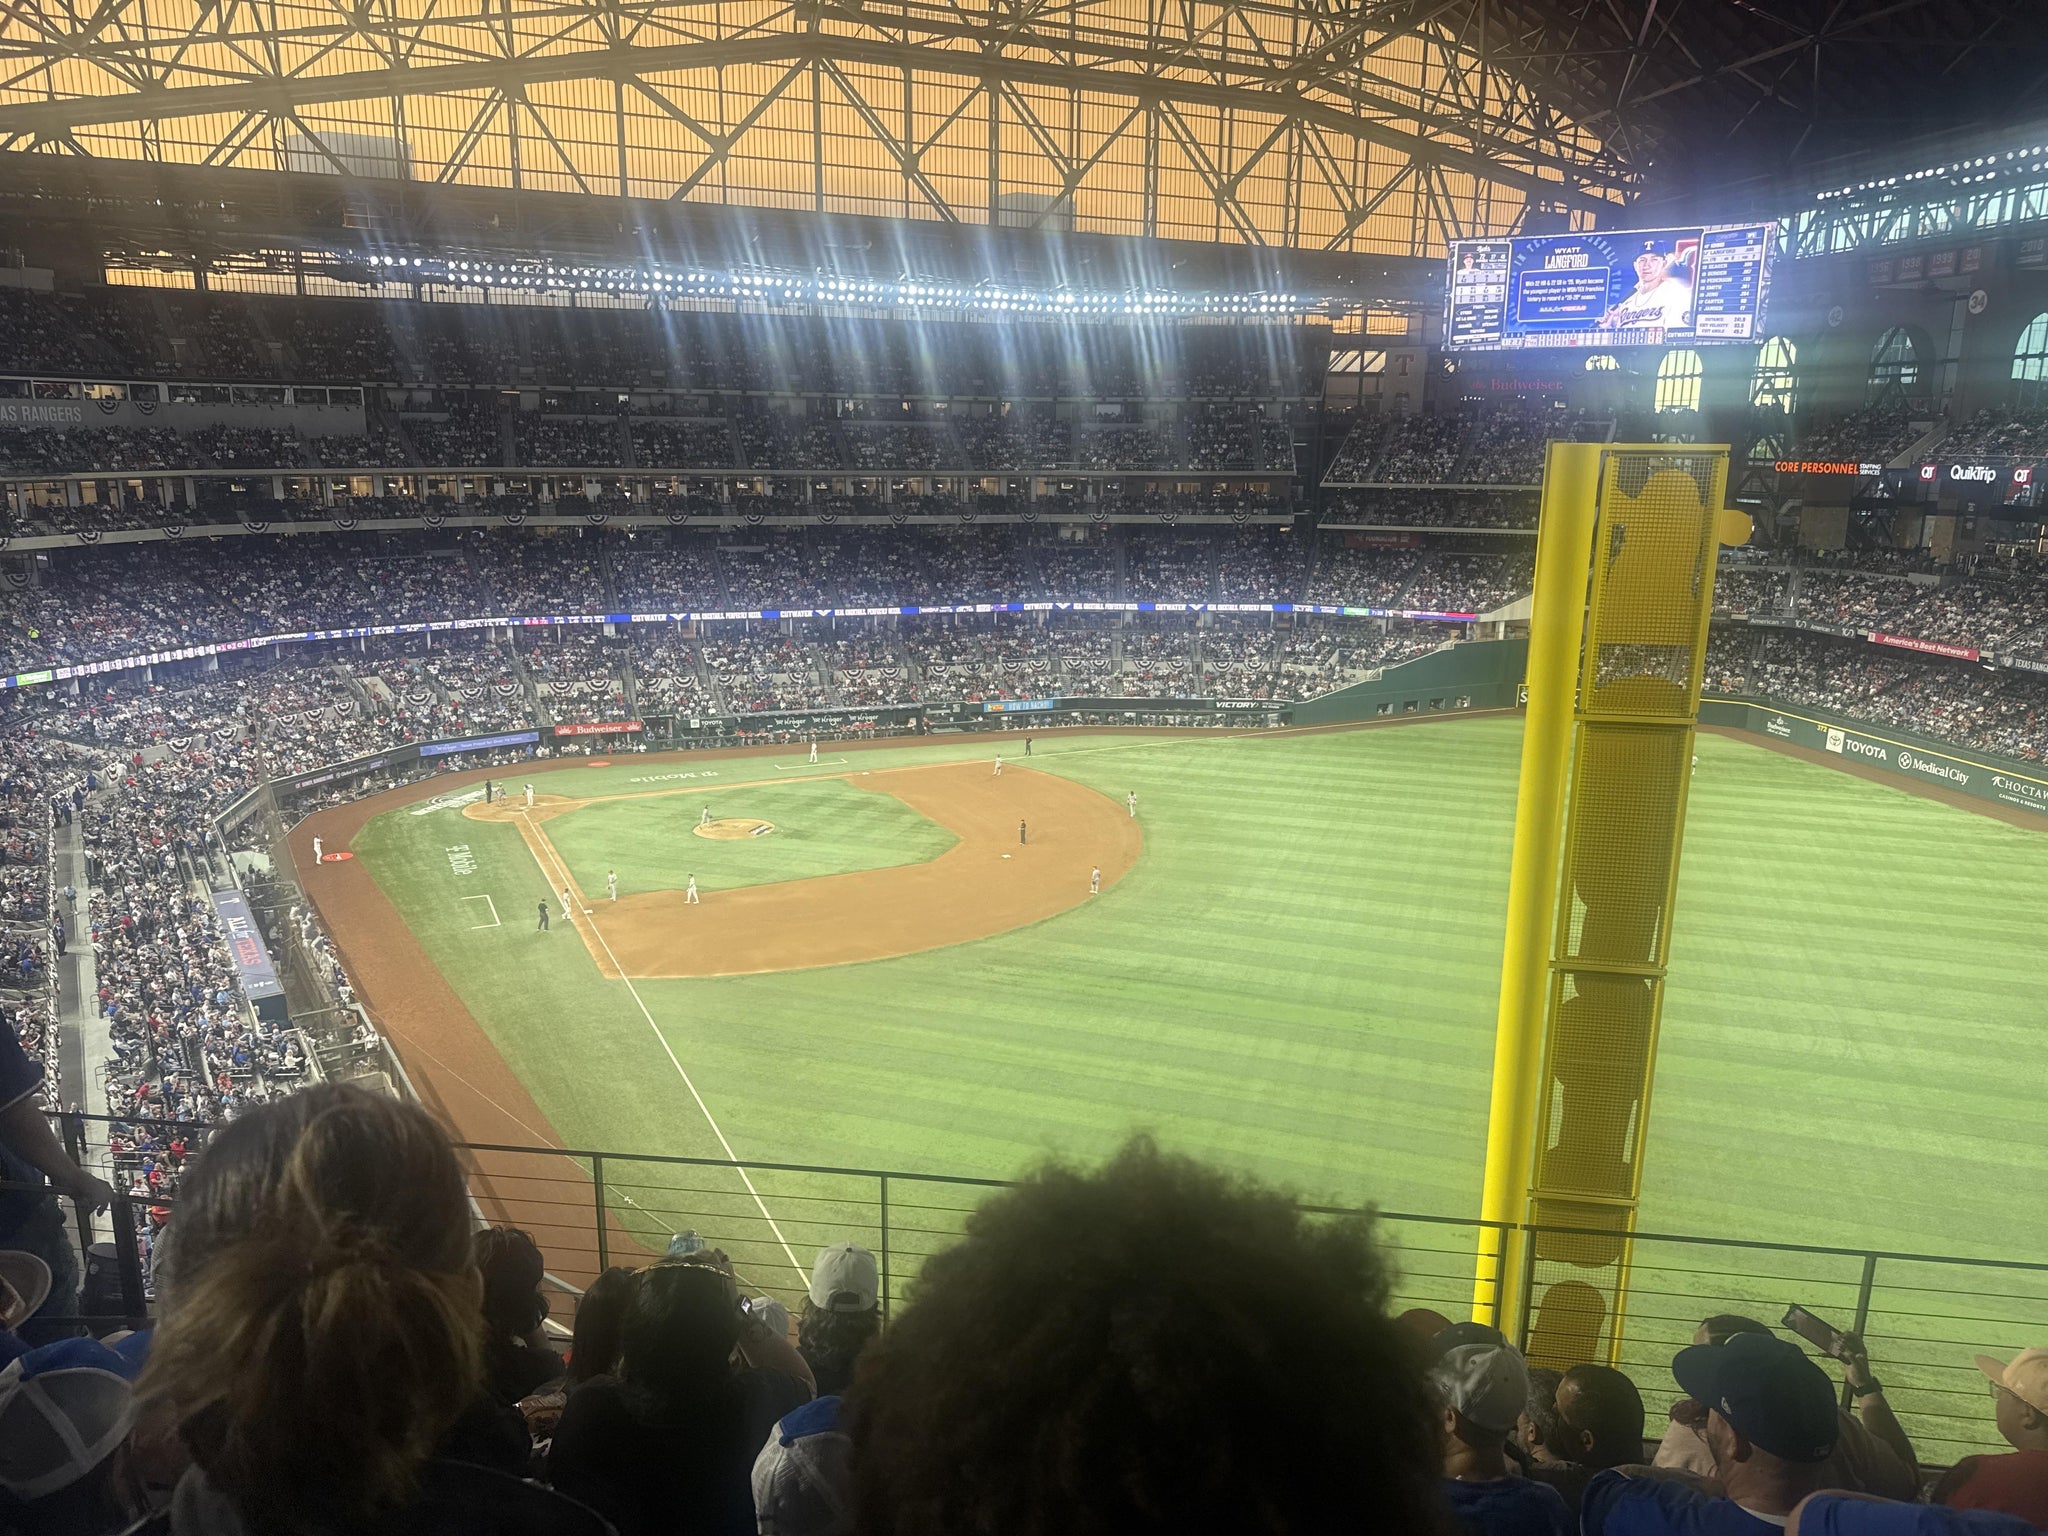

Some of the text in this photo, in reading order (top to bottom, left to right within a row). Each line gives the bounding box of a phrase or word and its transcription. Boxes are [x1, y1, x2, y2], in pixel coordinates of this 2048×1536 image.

[1544, 253, 1589, 270] LANGFORD
[1970, 295, 1985, 310] 34
[1620, 306, 1665, 322] Rangers
[1394, 354, 1414, 376] T
[22, 406, 82, 422] RANGERS
[1775, 462, 1859, 474] CORE PERSONNEL
[1921, 466, 1934, 479] QT
[1950, 464, 1996, 484] QuikTrip
[2014, 469, 2030, 482] QT
[1810, 624, 1830, 633] American
[1883, 636, 1970, 657] America's Best Network
[2016, 659, 2031, 669] TEXAS
[784, 717, 806, 728] Kroger
[822, 715, 843, 726] Kroger
[858, 713, 879, 724] Kroger
[577, 725, 622, 734] Budweiser
[1846, 739, 1886, 760] TOYOTA
[630, 772, 698, 782] Mobile
[1913, 758, 1969, 785] Medical City
[1999, 794, 2019, 803] CASINOS
[448, 851, 478, 875] Mobile
[236, 937, 262, 966] TEXAS
